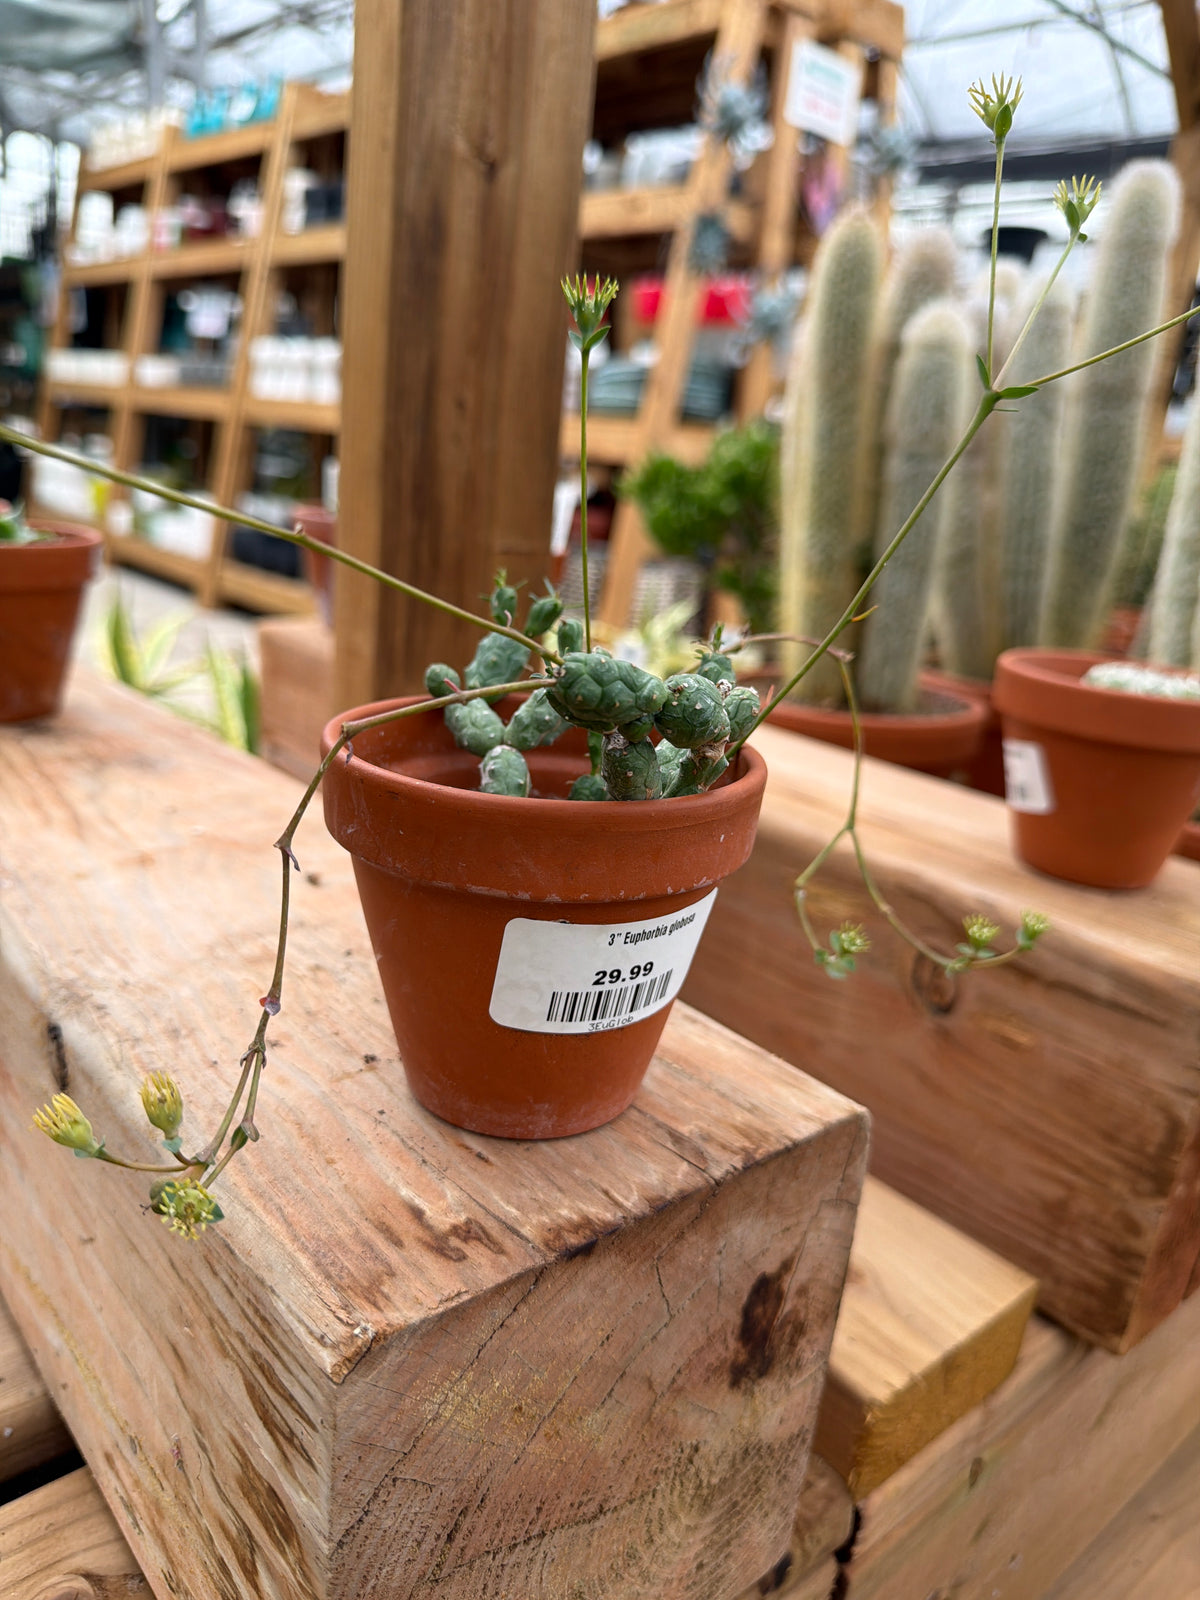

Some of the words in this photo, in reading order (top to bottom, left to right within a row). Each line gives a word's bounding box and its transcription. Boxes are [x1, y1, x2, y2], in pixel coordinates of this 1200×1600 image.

[608, 932, 622, 946] 3"
[623, 924, 668, 946] Euphorbia
[668, 912, 697, 936] globosa
[591, 961, 654, 986] 29.99
